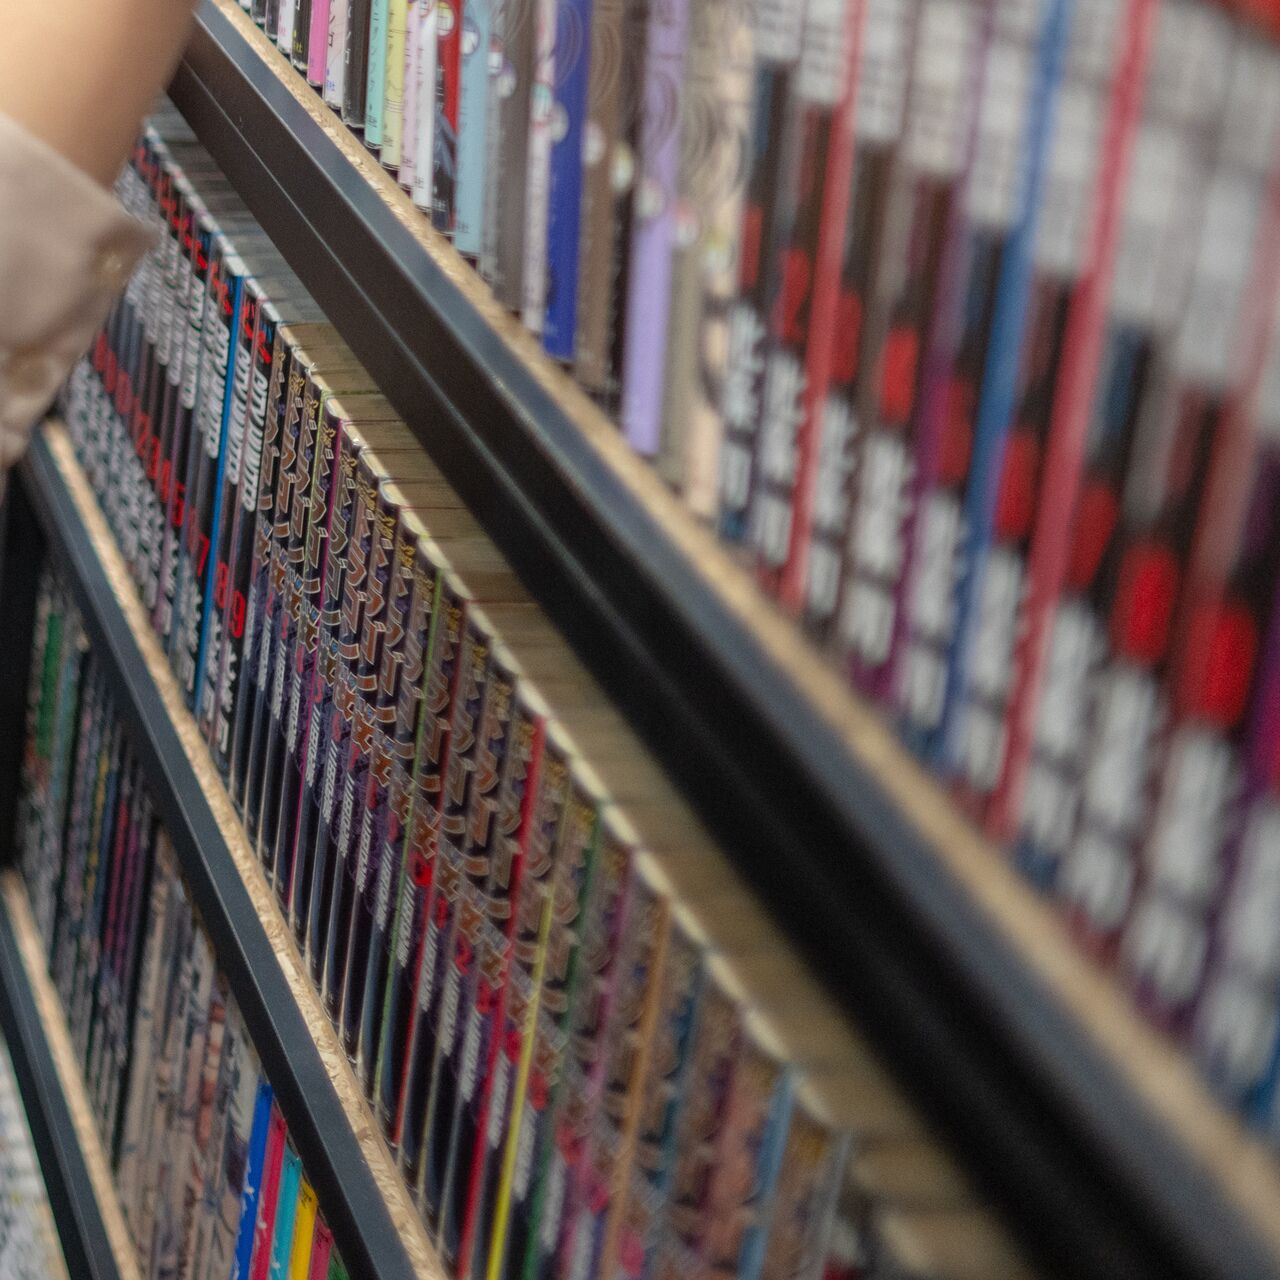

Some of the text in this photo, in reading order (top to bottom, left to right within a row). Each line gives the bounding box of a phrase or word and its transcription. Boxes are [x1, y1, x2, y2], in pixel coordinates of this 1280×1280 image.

[230, 367, 269, 639] CITY HUNTER 9
